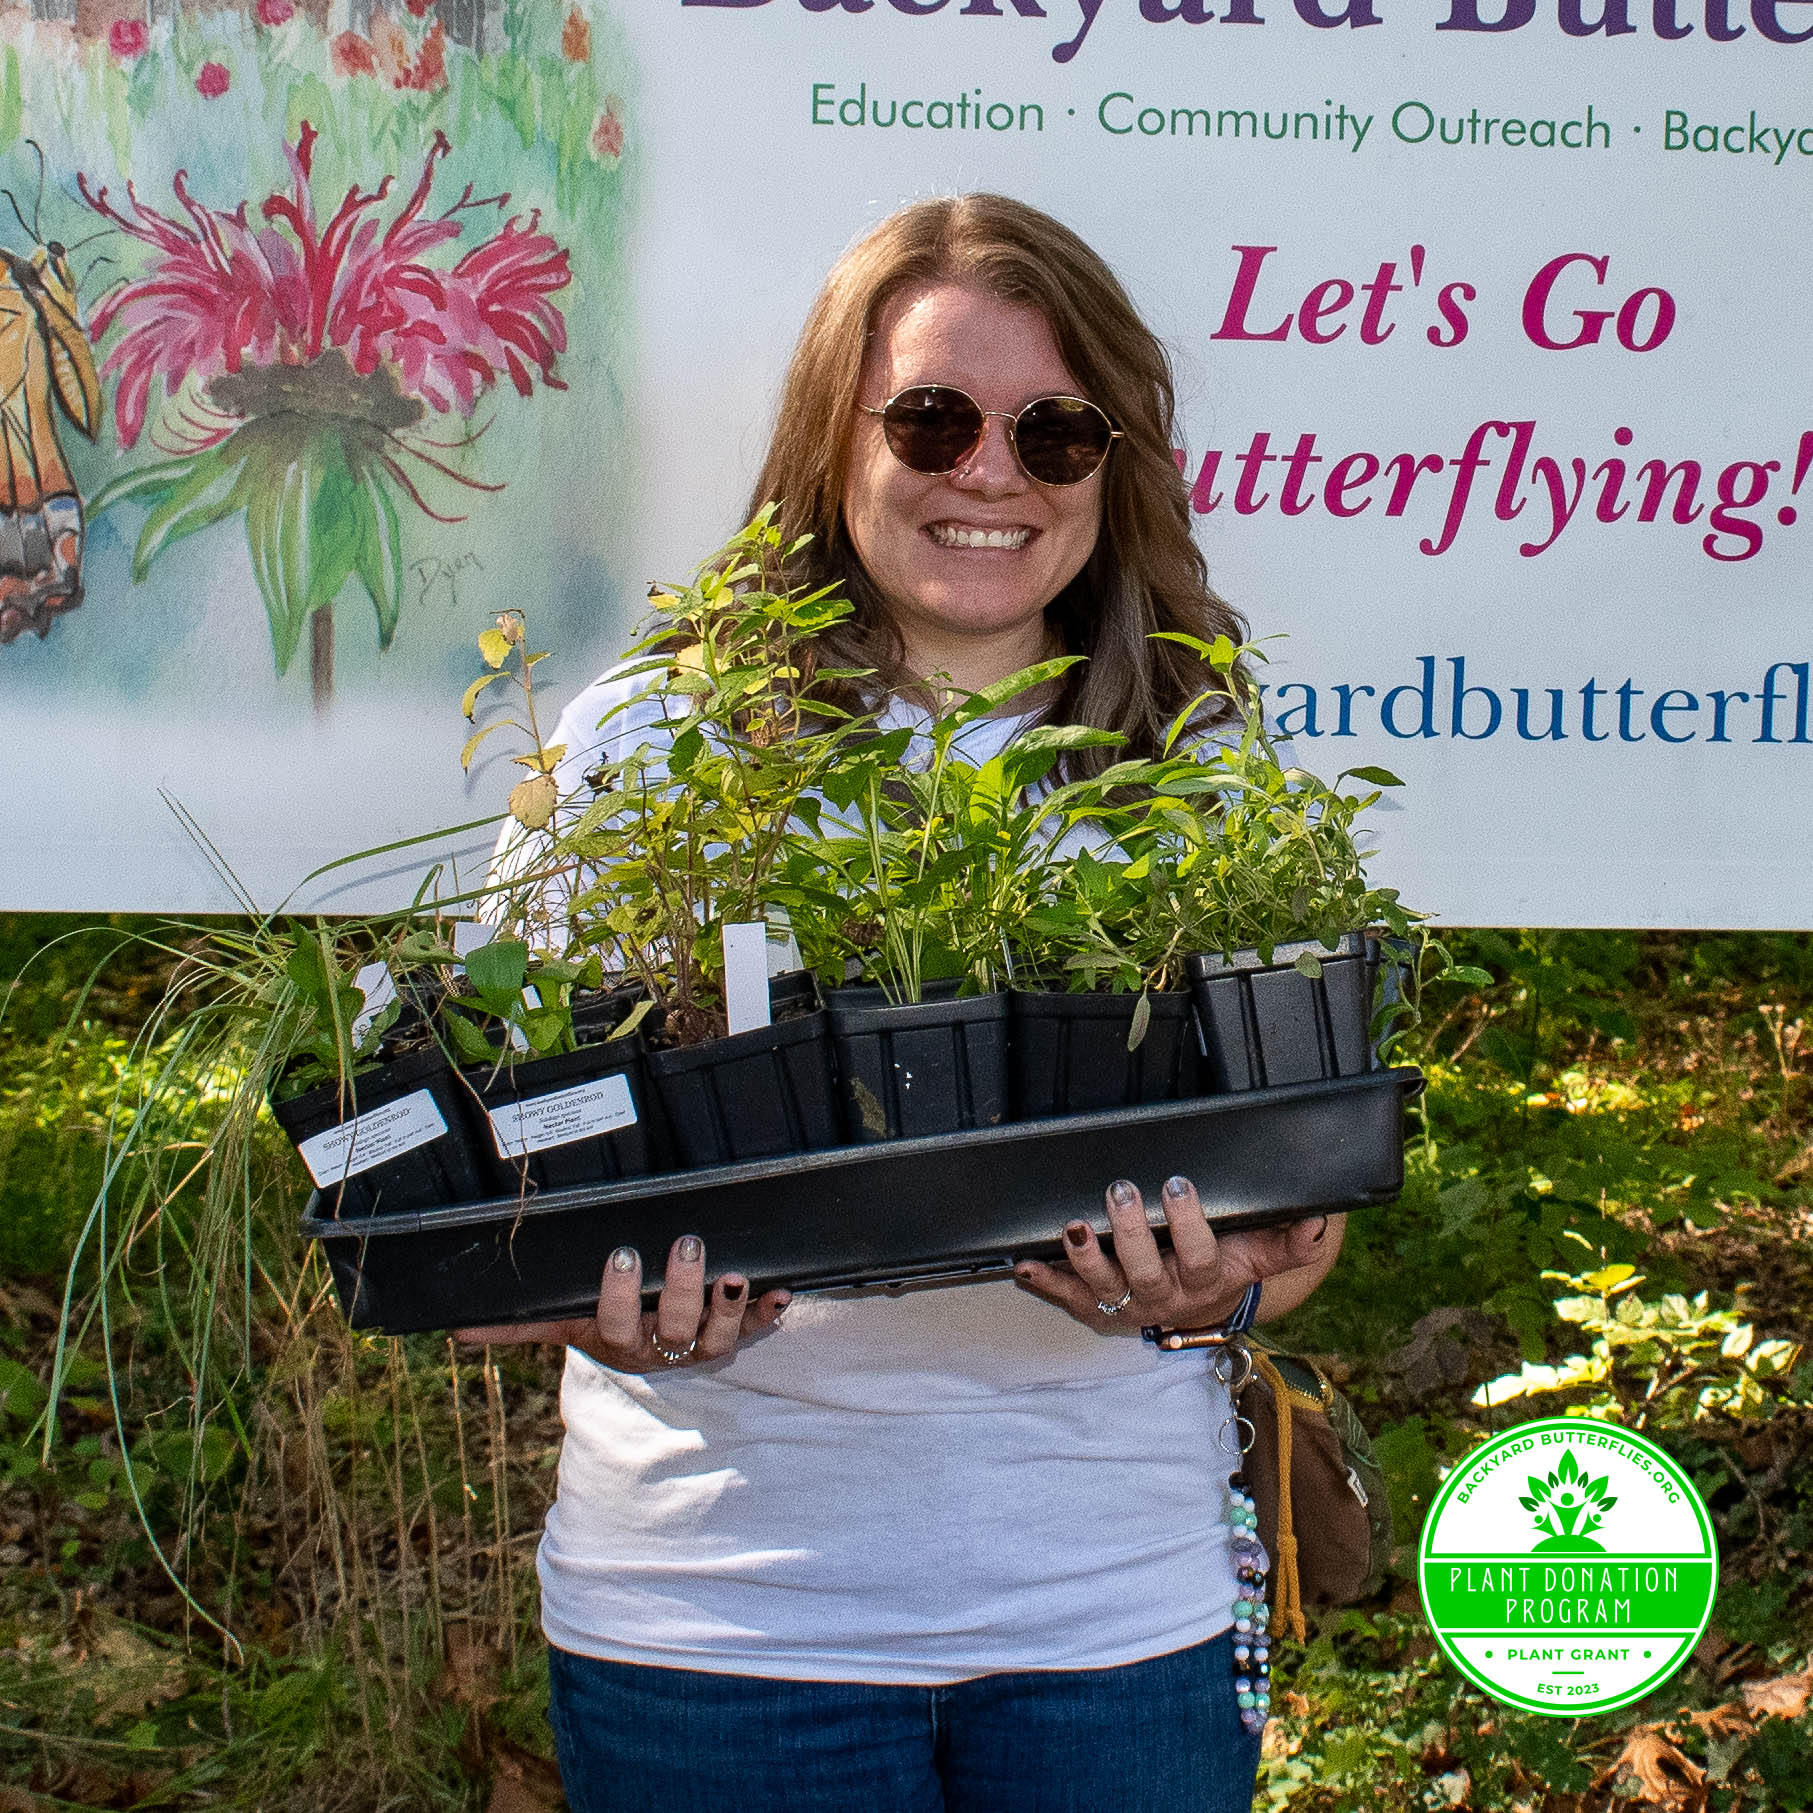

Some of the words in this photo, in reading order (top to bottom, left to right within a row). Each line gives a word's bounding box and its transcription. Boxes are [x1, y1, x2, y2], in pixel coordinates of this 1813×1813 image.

[812, 82, 1043, 131] Education
[1098, 91, 1374, 153] Community
[1392, 101, 1611, 148] Outreach
[1211, 244, 1476, 347] Let's
[1522, 253, 1676, 352] Go
[1260, 655, 1813, 743] ardbutterfl
[511, 1106, 546, 1123] SHOWY
[545, 1090, 604, 1114] GOLDENROD
